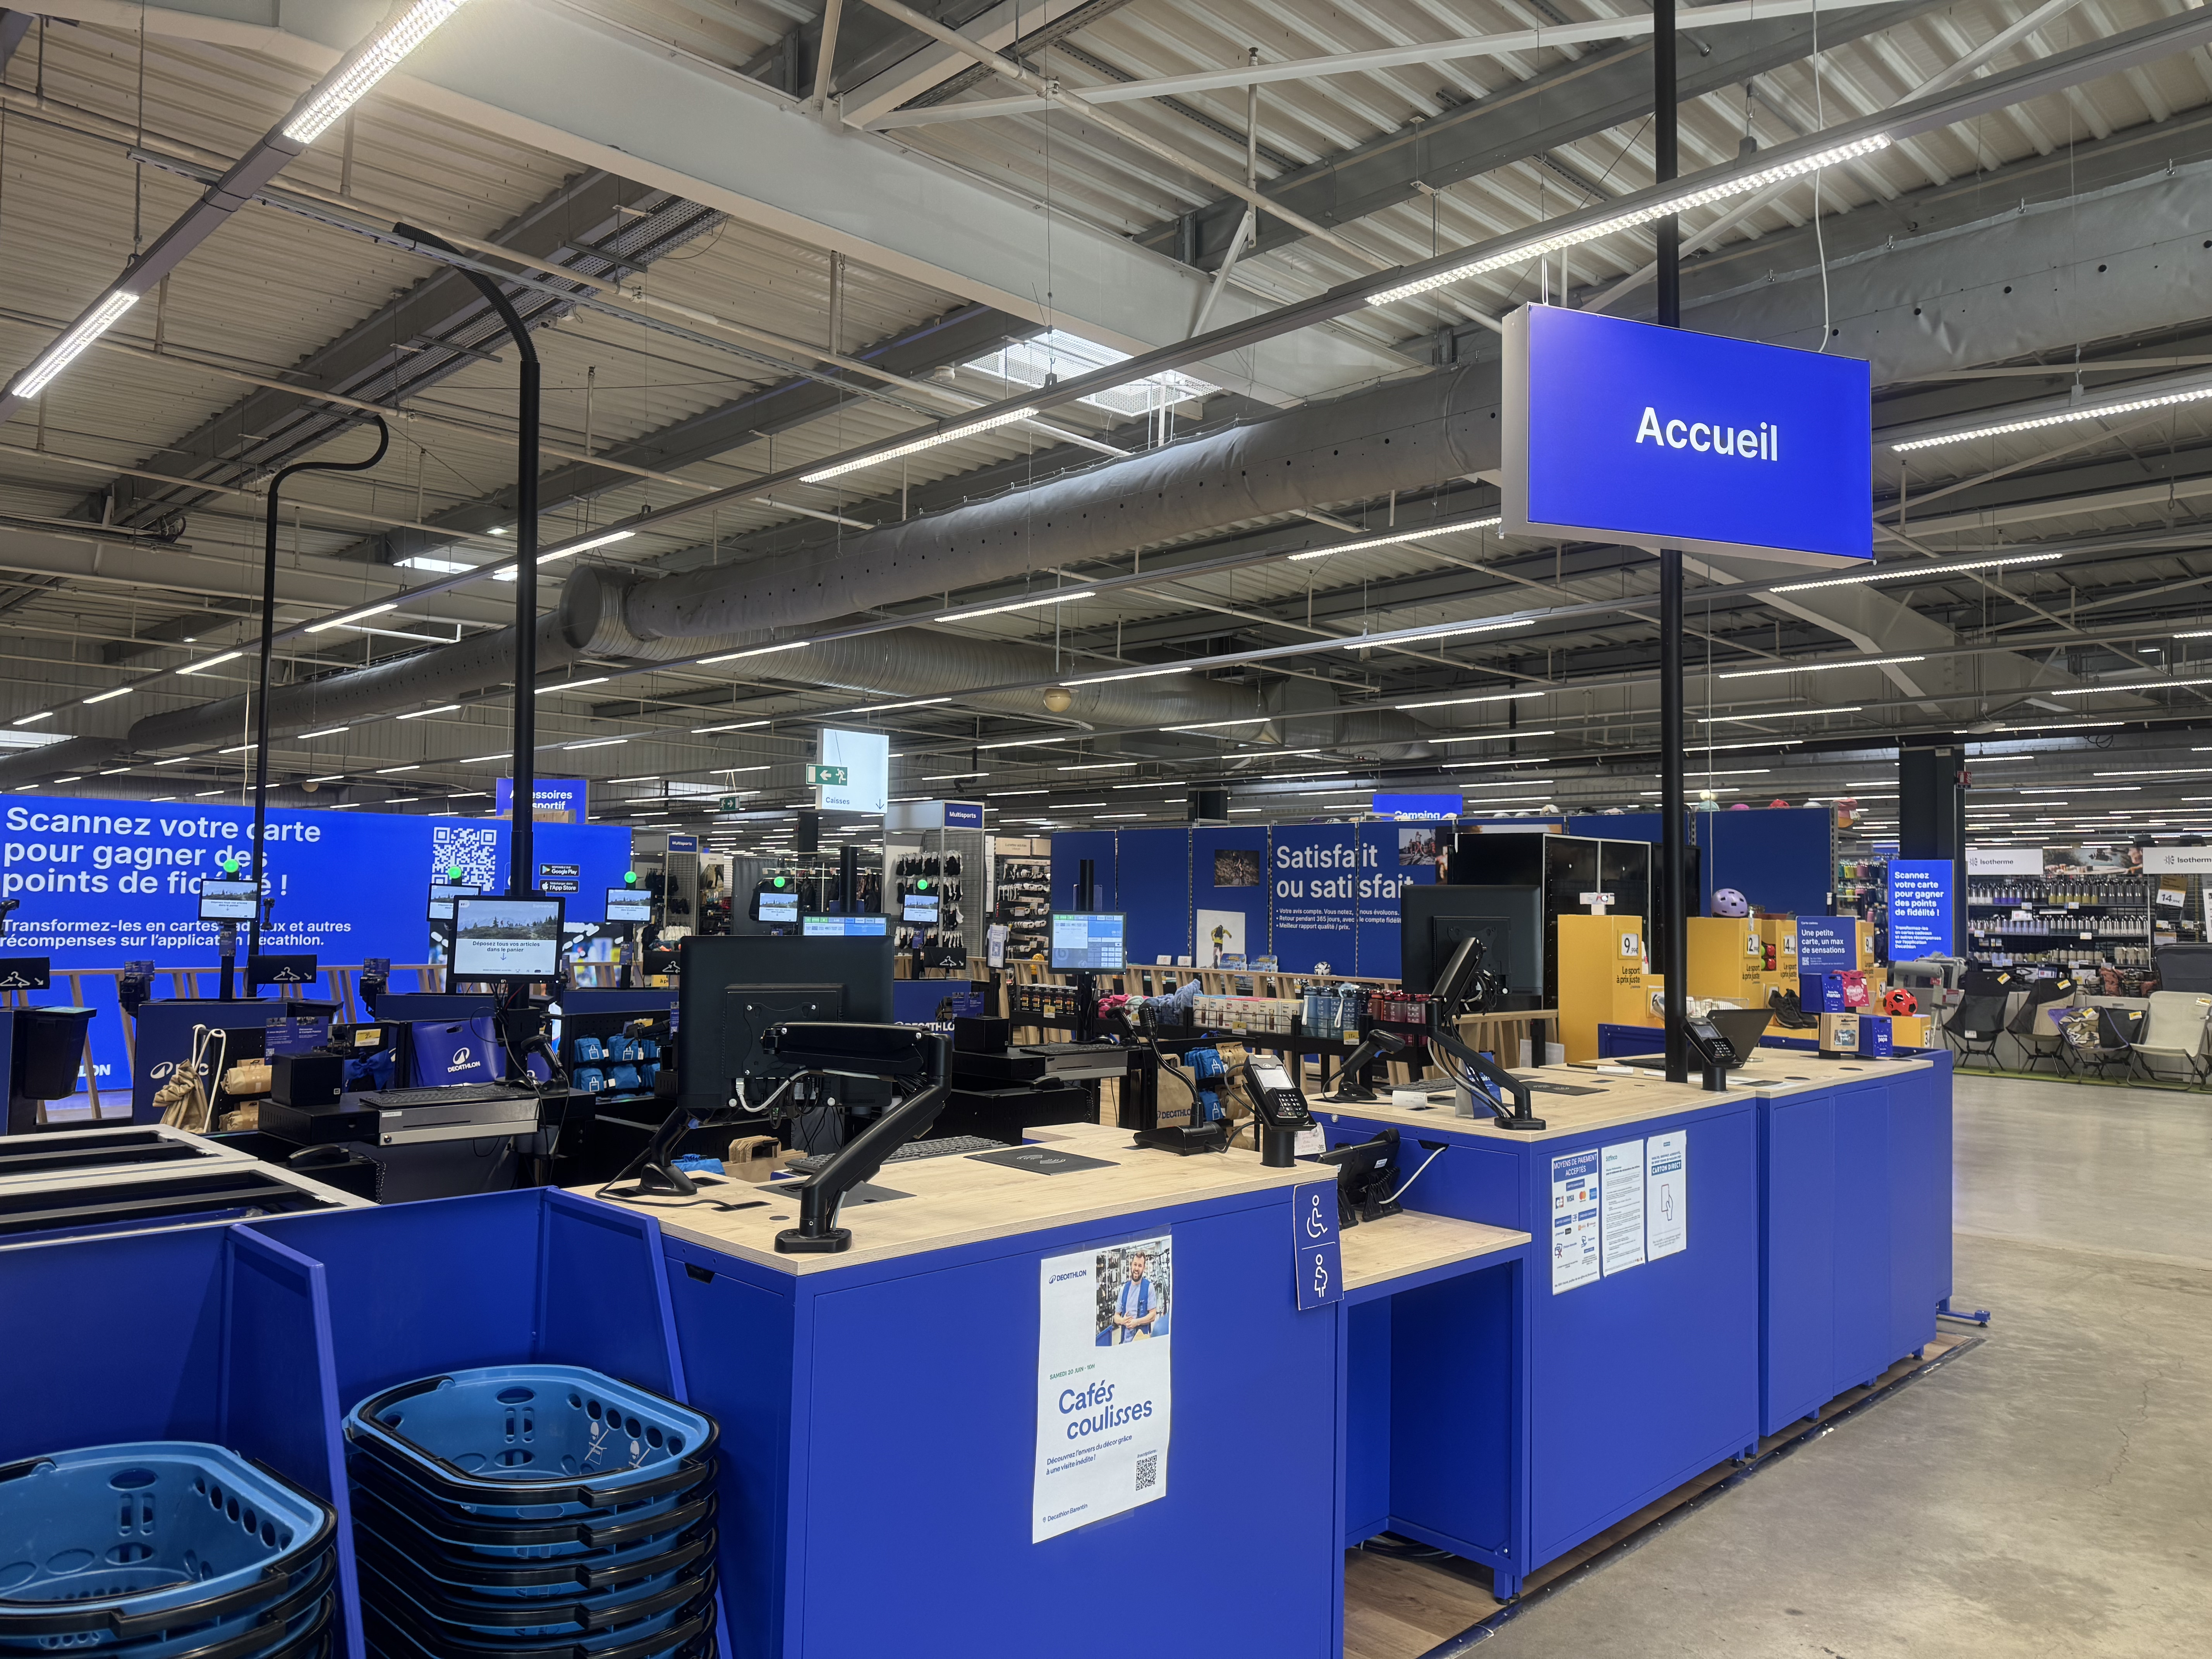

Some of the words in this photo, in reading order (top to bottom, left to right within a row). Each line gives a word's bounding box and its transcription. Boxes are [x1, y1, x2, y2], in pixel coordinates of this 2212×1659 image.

[1635, 407, 1778, 461] Accueil
[826, 797, 850, 805] Caisses
[949, 811, 976, 819] Multisports
[6, 807, 151, 836] Scannez
[160, 817, 239, 839] votre
[4, 842, 84, 867] pour
[93, 845, 206, 871] gagner
[1276, 843, 1378, 869] Satisfait
[2, 868, 109, 898] points
[118, 871, 158, 894] de
[280, 874, 287, 896] !
[1276, 880, 1303, 898] ou
[1911, 899, 1937, 908] points
[1907, 908, 1935, 917] fidélité
[2, 919, 142, 932] Transformez-les
[146, 922, 165, 932] en
[170, 920, 219, 932] cartes
[289, 921, 304, 932] et
[307, 922, 351, 933] autres
[1815, 929, 1834, 937] petite
[0, 934, 116, 950] récompenses
[120, 936, 147, 946] sur
[1622, 966, 1628, 974] Le
[1628, 967, 1640, 977] sport
[1616, 975, 1620, 984] à
[1620, 975, 1629, 985] prix
[1629, 974, 1640, 985] juste
[447, 1061, 481, 1073] DECATHLON
[1553, 1160, 1571, 1169] MOYENS
[1578, 1154, 1597, 1164] PAIEMENT
[1652, 1164, 1667, 1174] CARTON
[1668, 1161, 1681, 1170] DIRECT
[1565, 1164, 1586, 1176] ACCEPTÉS
[1057, 1269, 1087, 1281] DECATHLON
[1050, 1370, 1067, 1380] SAMEDI
[1059, 1379, 1115, 1414] Cafés
[1067, 1400, 1152, 1440] coulisses
[1047, 1452, 1075, 1466] Découvrez
[1076, 1445, 1096, 1457] l'envers
[1103, 1439, 1118, 1449] décor
[1118, 1435, 1132, 1445] grâce
[1061, 1462, 1075, 1471] visite
[1076, 1456, 1094, 1466] inédite
[1048, 1511, 1070, 1522] Decathlon
[1070, 1503, 1088, 1514] Barentin
